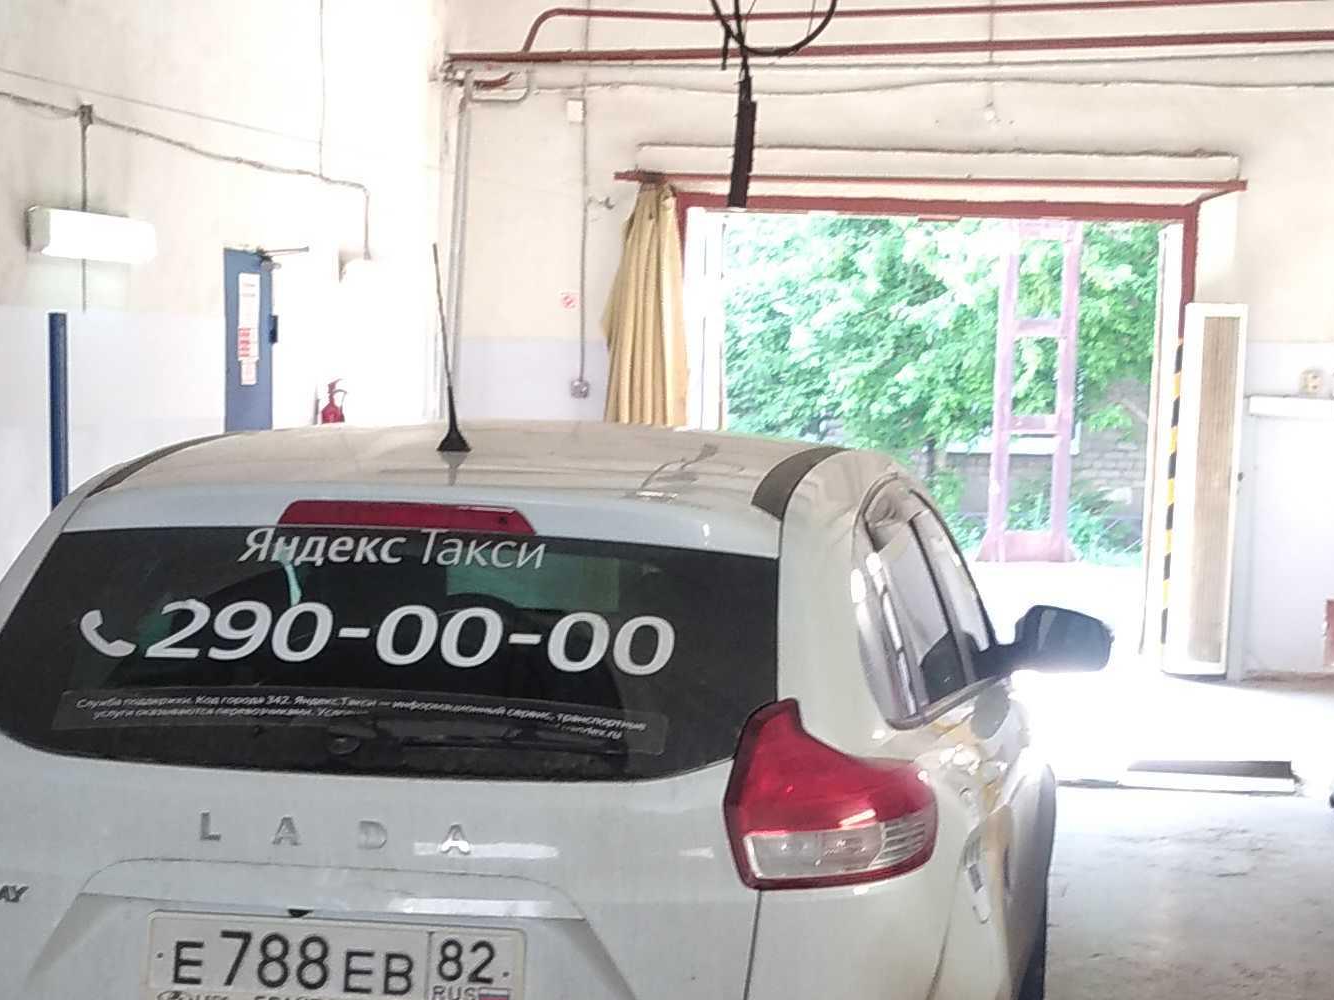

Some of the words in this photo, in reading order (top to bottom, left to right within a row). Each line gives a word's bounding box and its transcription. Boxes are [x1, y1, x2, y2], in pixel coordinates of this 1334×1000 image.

[238, 528, 405, 565] Яндекс
[420, 531, 547, 569] Такси
[144, 598, 676, 676] 290-00-00
[200, 810, 472, 856] LADA
[172, 929, 415, 997] Е788ЕВ
[438, 938, 496, 985] 82
